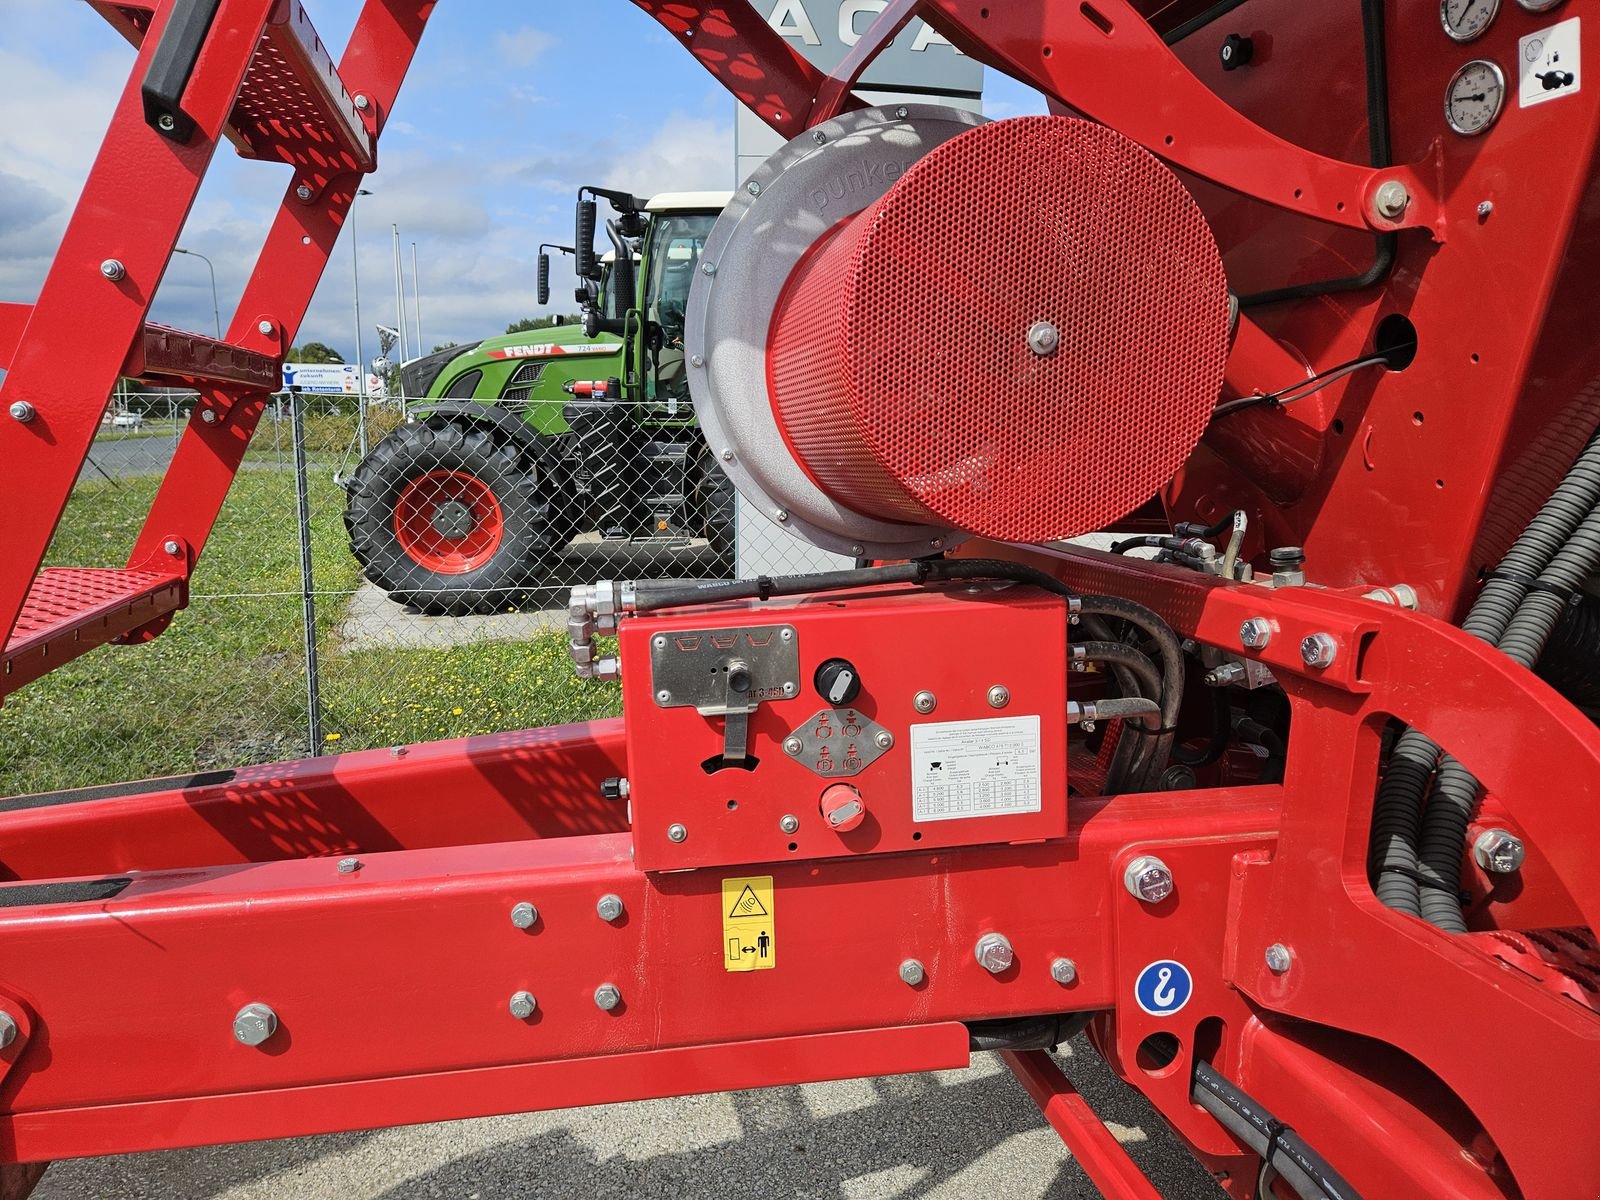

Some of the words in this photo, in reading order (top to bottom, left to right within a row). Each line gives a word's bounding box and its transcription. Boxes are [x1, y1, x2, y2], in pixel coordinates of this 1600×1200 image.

[808, 159, 914, 217] punker
[503, 343, 555, 357] FENDT
[697, 581, 730, 590] WABCO
